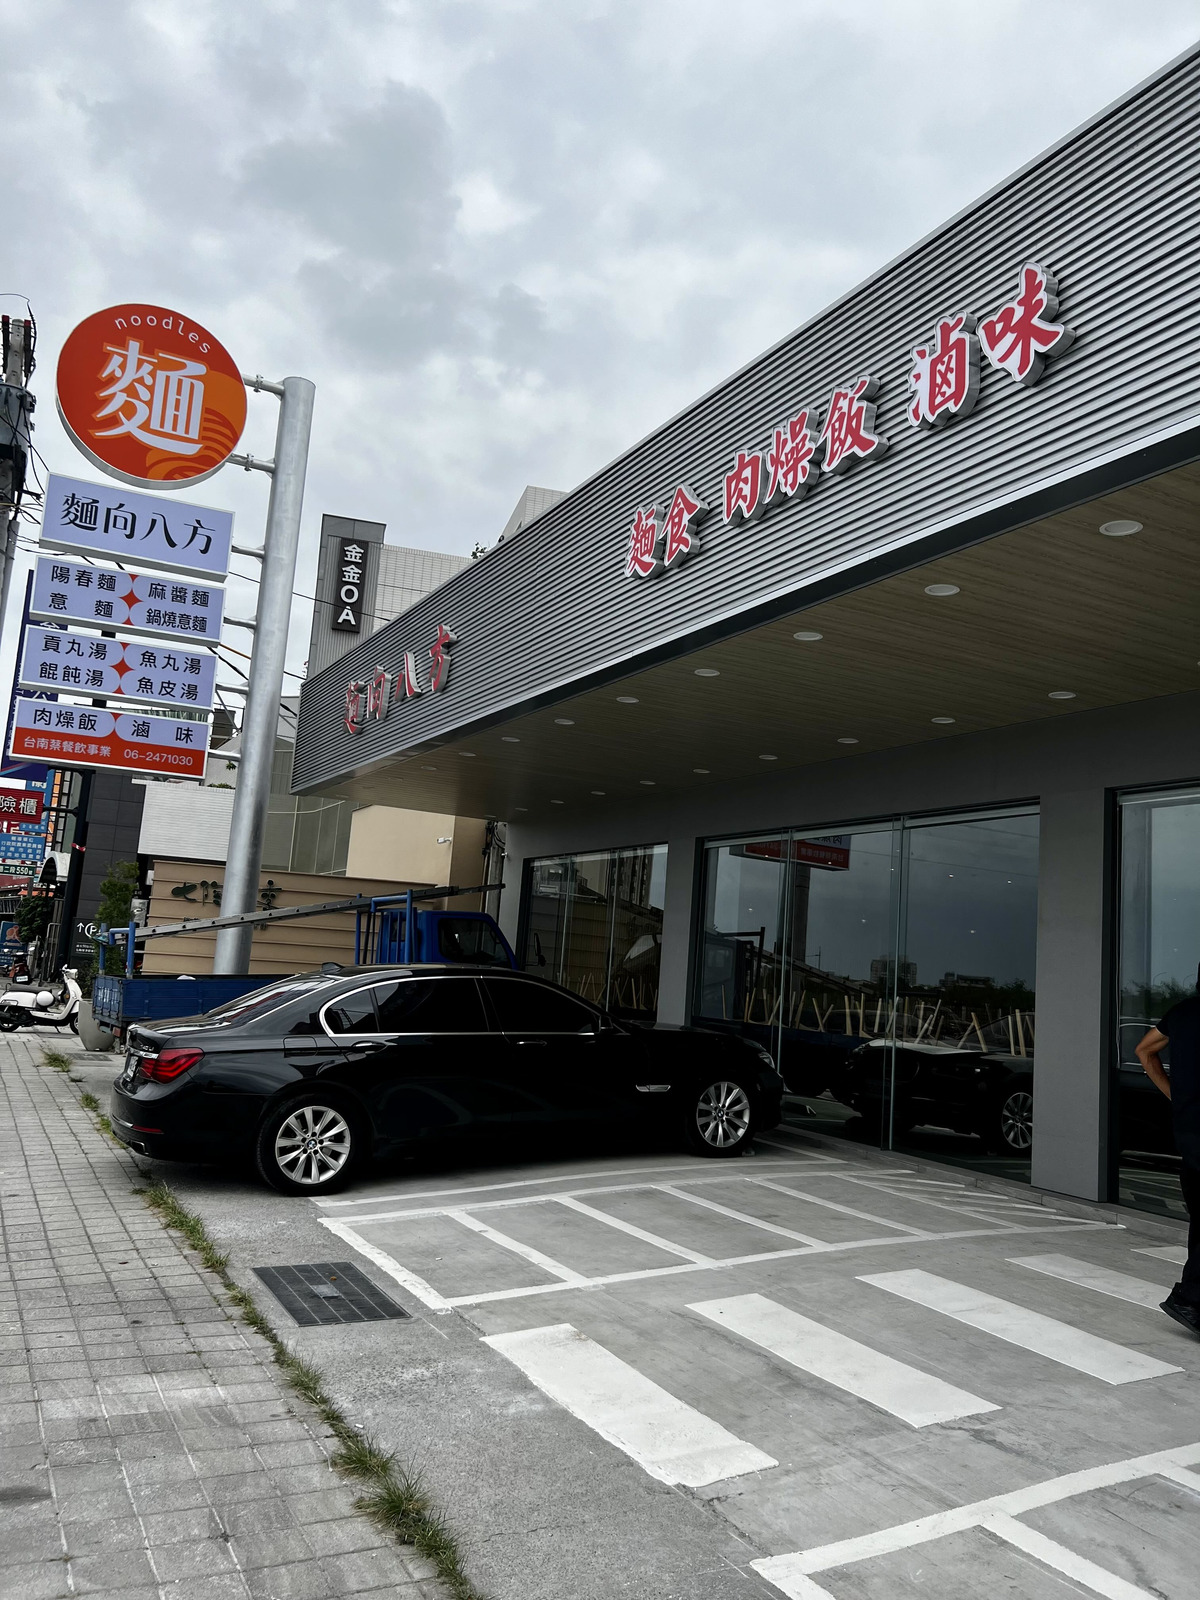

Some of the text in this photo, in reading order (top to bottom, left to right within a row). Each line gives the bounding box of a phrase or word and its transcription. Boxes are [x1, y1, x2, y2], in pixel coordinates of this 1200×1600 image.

[114, 314, 211, 354] noodles
[94, 339, 207, 456] 麵
[625, 262, 1070, 577] 麵食 肉燥飯 滷味
[60, 493, 217, 556] 麵向八方
[51, 565, 117, 592] 陽春麵
[336, 543, 366, 626] 金金OA
[148, 582, 210, 608] 麻醬麵
[145, 608, 208, 633] 鍋燒意麵
[41, 634, 108, 661] 貢丸湯
[39, 661, 105, 688] 餛飩湯
[139, 650, 202, 676] 魚丸湯
[136, 676, 199, 701] 魚皮湯
[33, 708, 99, 732] 肉燥飯
[23, 736, 194, 766] 台南蔡餐飲事業 06-2471030
